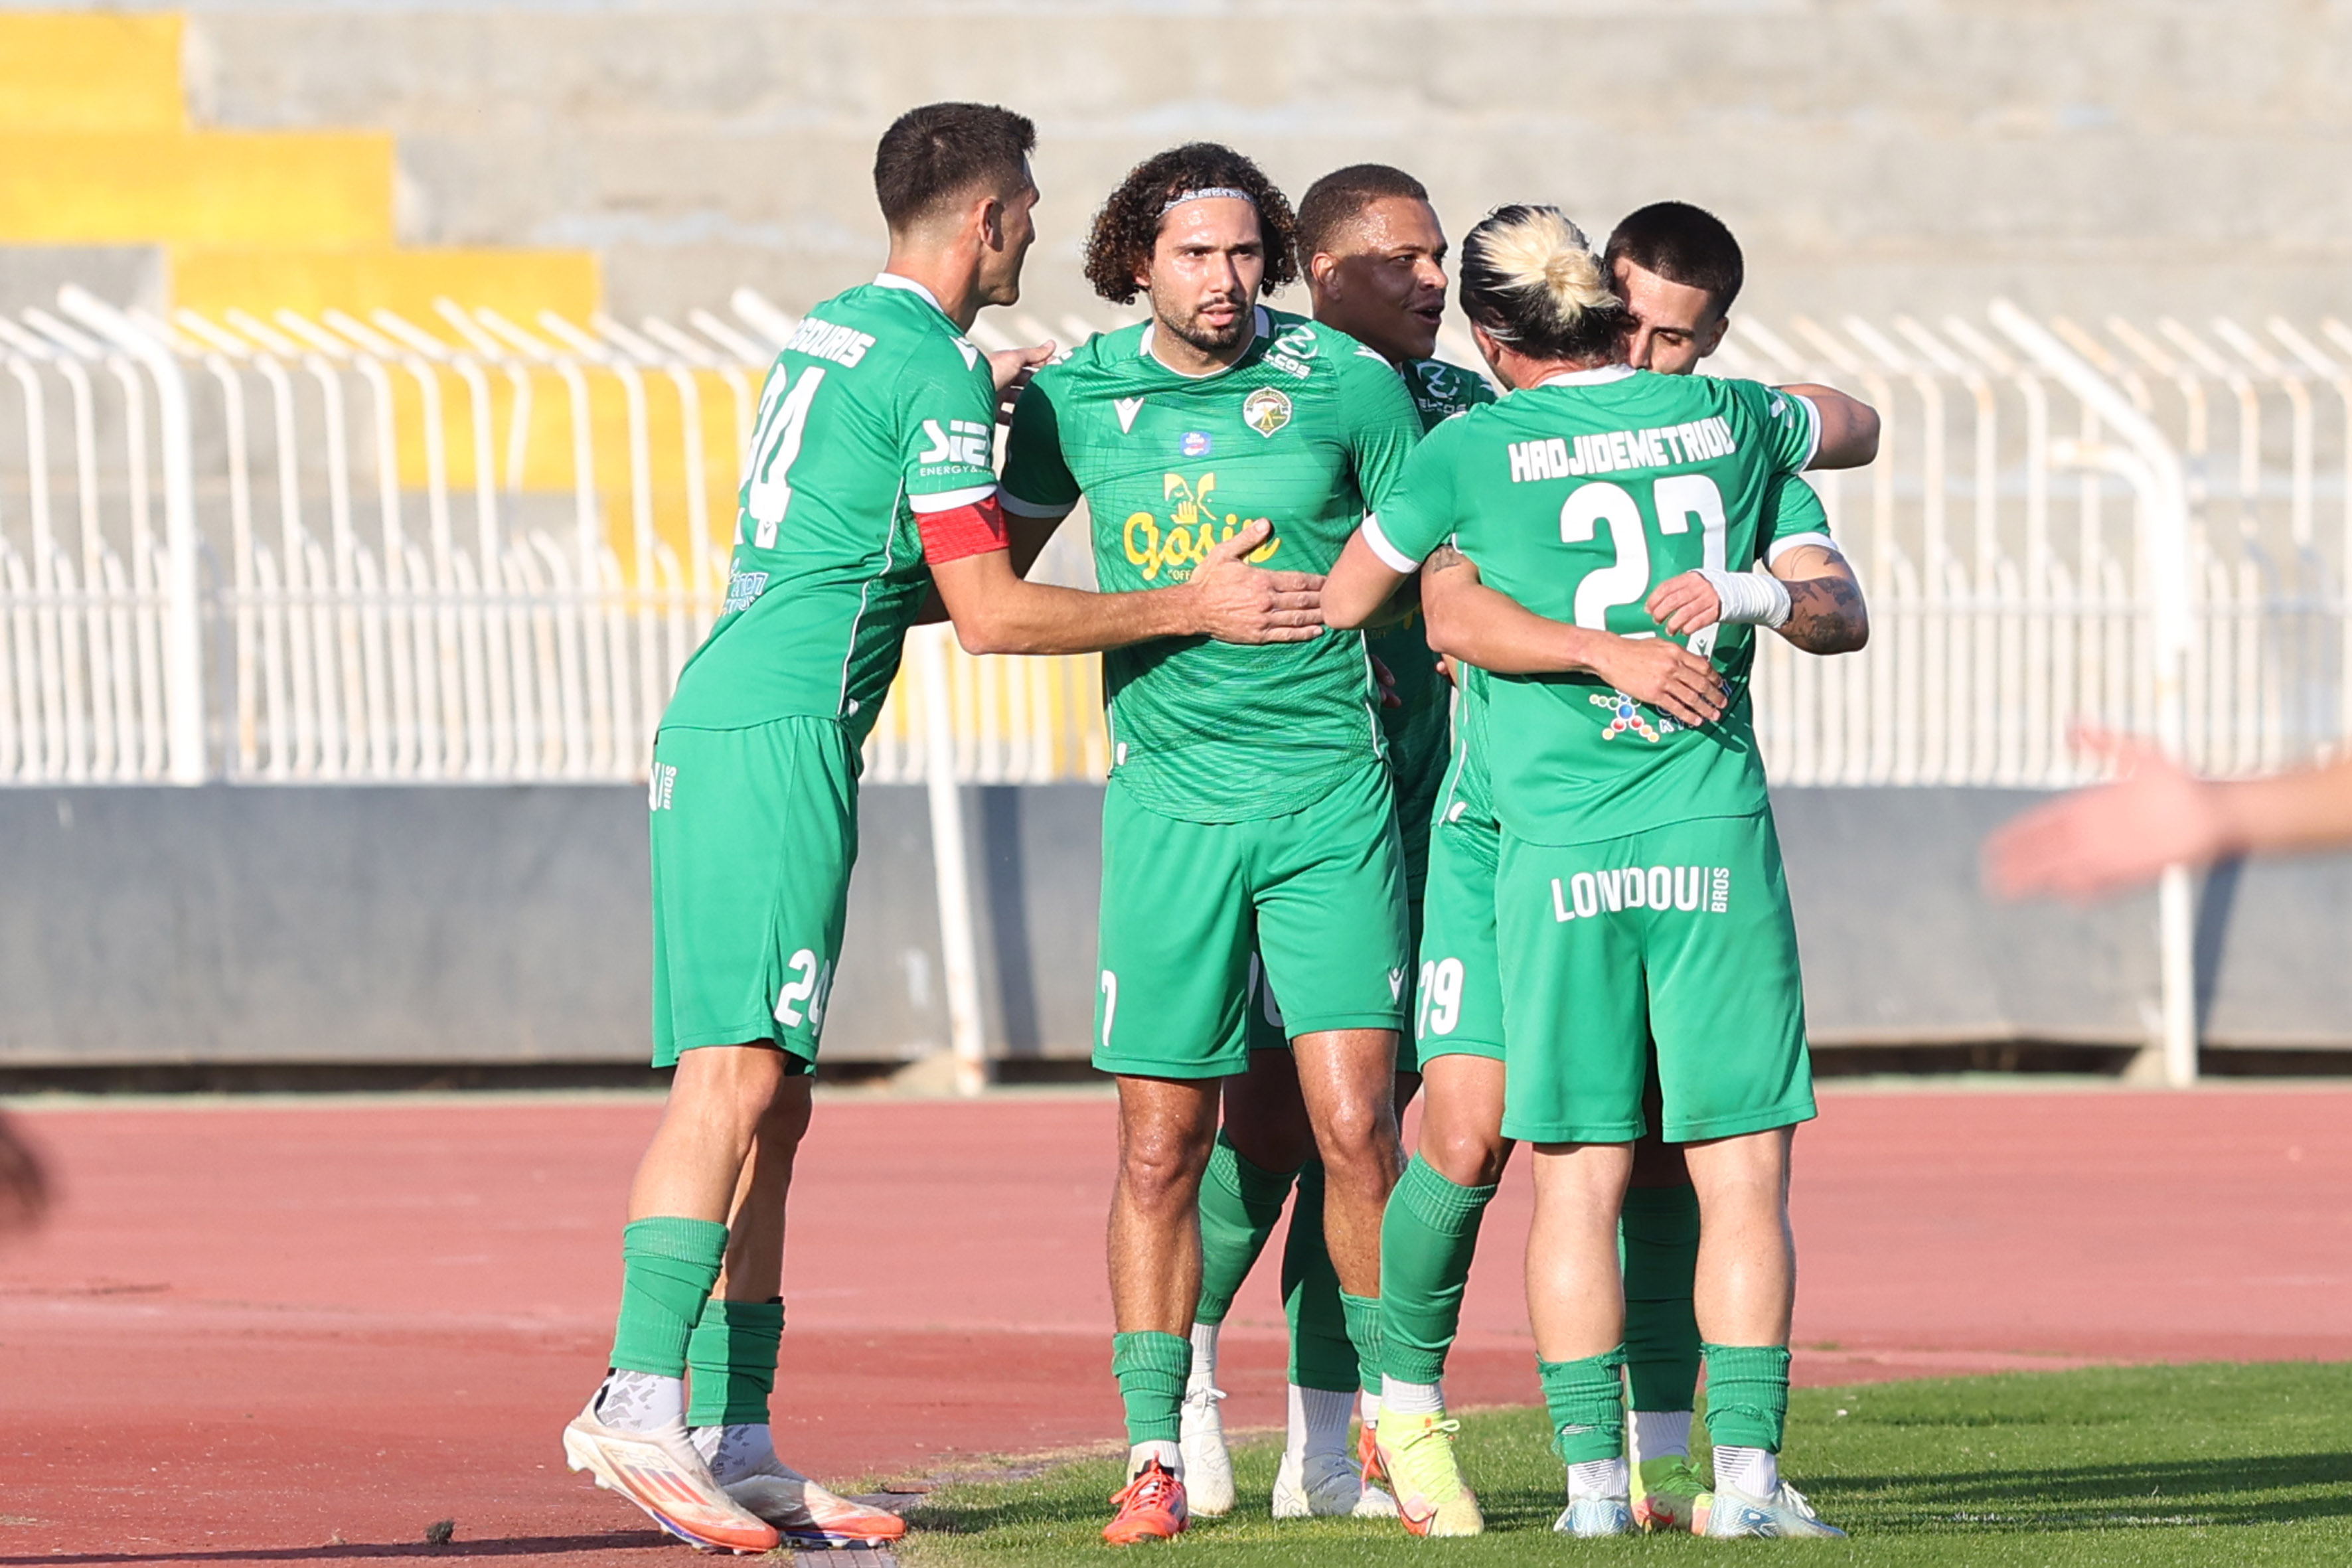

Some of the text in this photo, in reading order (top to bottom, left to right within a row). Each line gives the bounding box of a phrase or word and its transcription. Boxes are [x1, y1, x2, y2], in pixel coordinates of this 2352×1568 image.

[1508, 416, 1737, 483] HADJIDEMETRIOU
[1560, 474, 1726, 662] 27
[1551, 866, 1729, 922] LONDOU BROS
[774, 949, 830, 1036] 24
